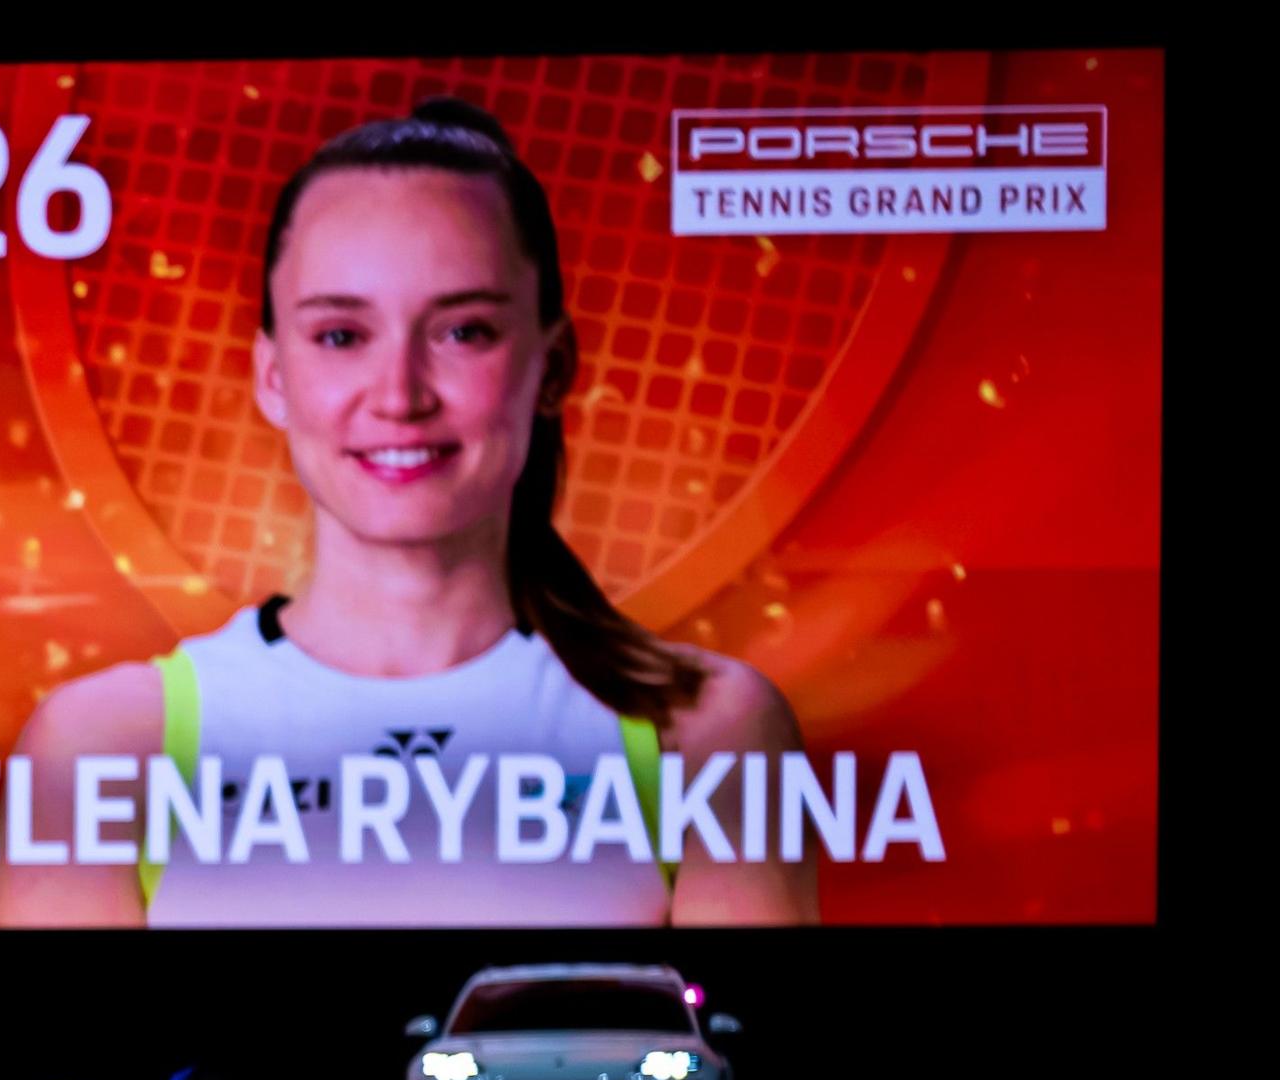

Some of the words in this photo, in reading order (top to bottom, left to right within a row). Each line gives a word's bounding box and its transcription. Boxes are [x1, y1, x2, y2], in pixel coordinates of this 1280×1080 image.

[689, 123, 1089, 161] PORSCHE
[692, 187, 833, 218] TENNIS
[849, 186, 983, 217] GRAND
[999, 184, 1086, 214] PRIX
[339, 750, 948, 864] RYBAKINA
